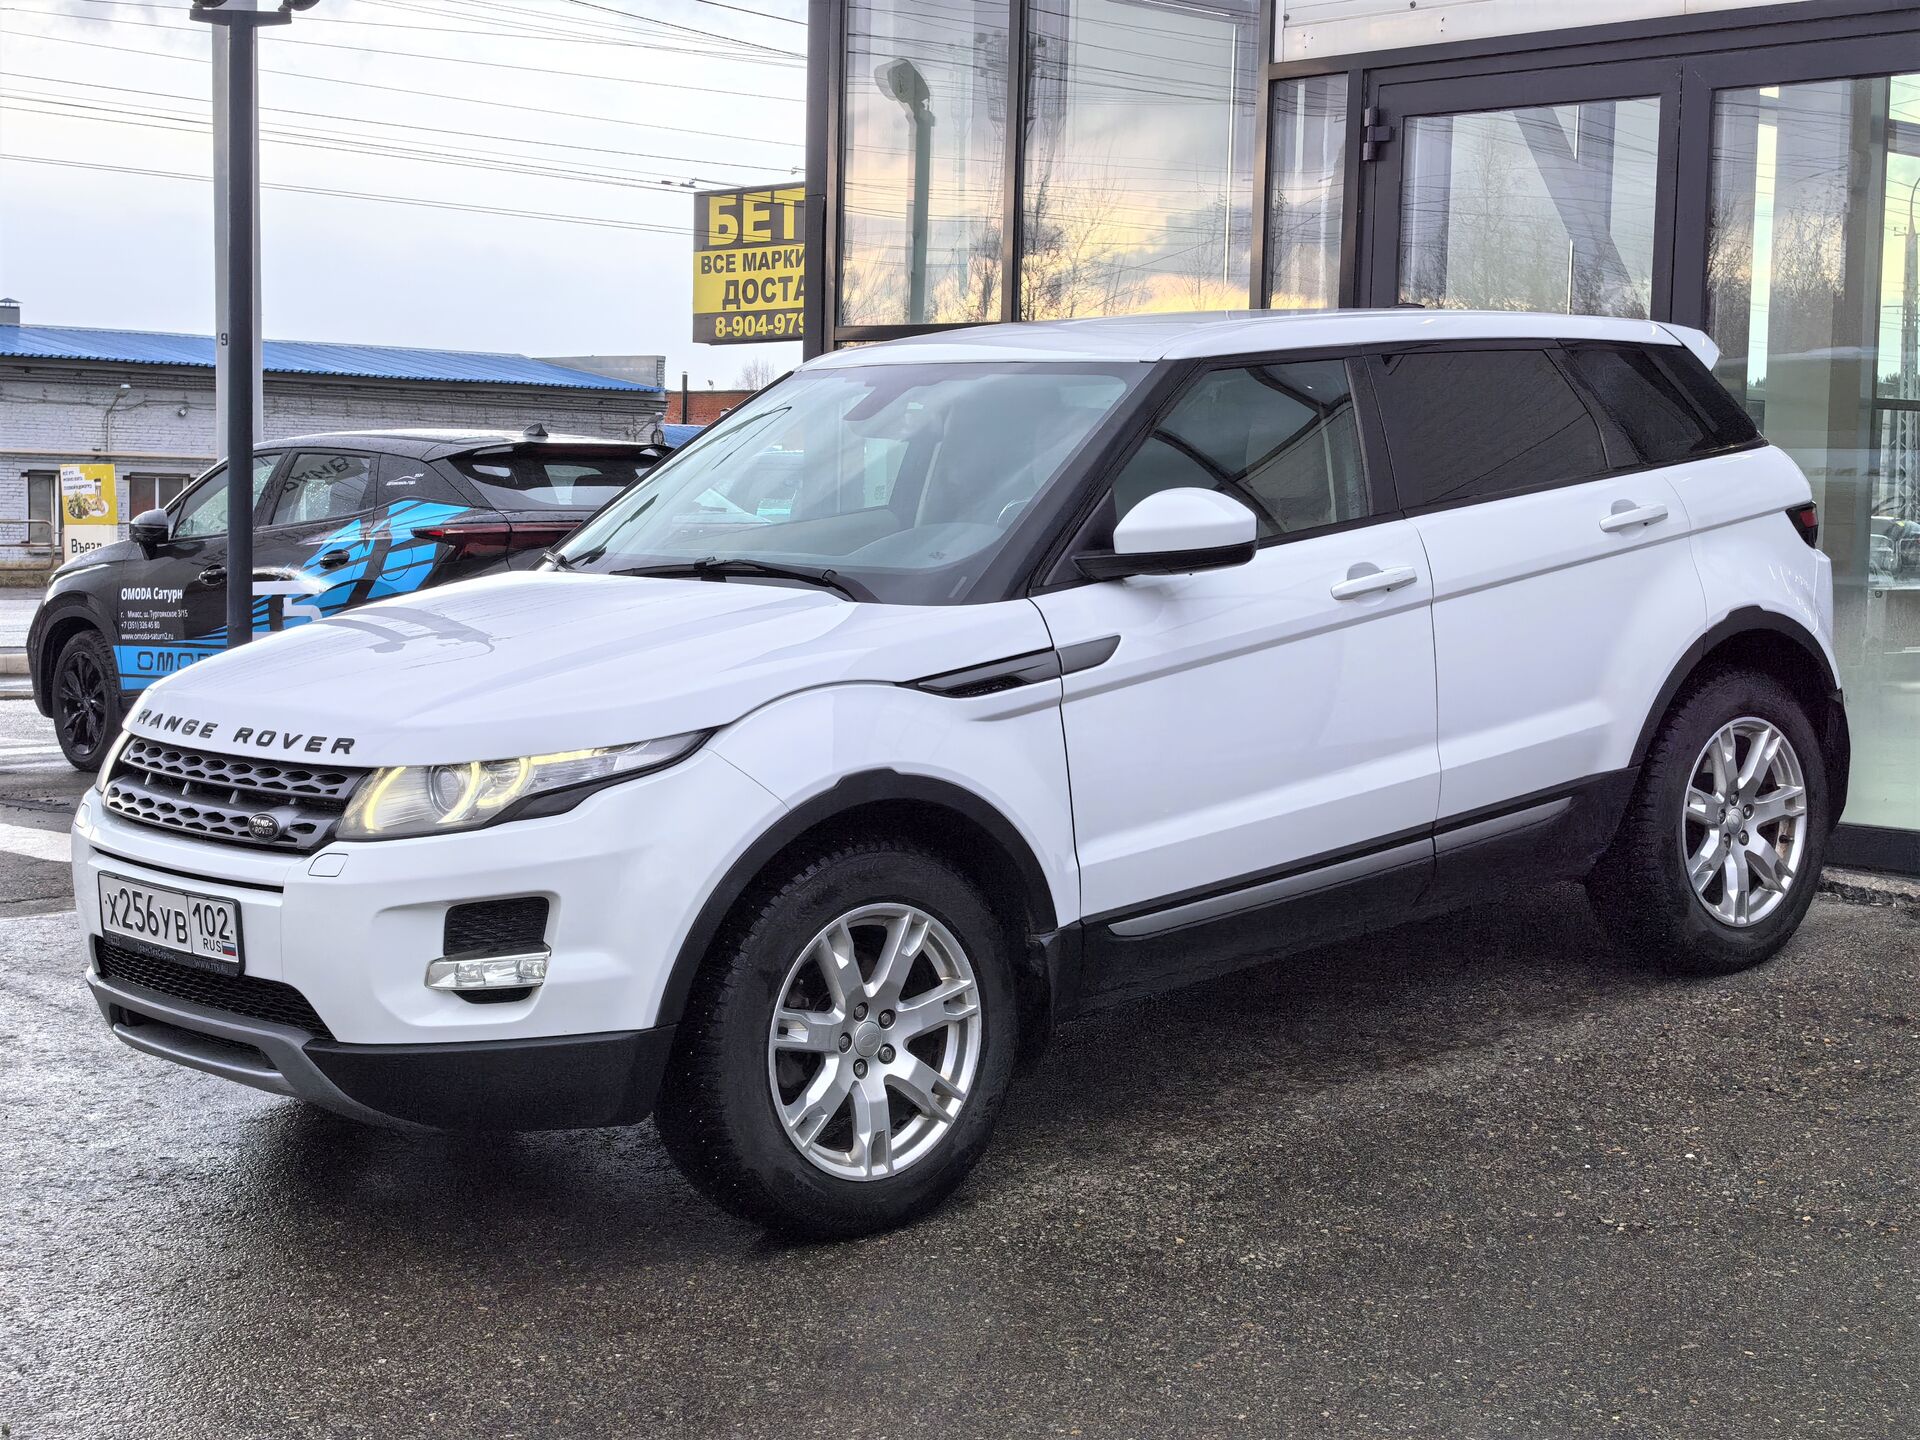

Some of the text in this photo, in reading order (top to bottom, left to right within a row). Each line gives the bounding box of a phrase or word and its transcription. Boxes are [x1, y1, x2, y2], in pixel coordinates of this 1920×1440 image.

[701, 254, 736, 274] ВСЕ
[221, 332, 229, 346] 9
[121, 587, 183, 603] OMODA Сатурн
[121, 621, 127, 629] +7
[136, 708, 356, 755] RANGE ROVER
[191, 902, 231, 941] 102
[203, 937, 223, 953] RUS
